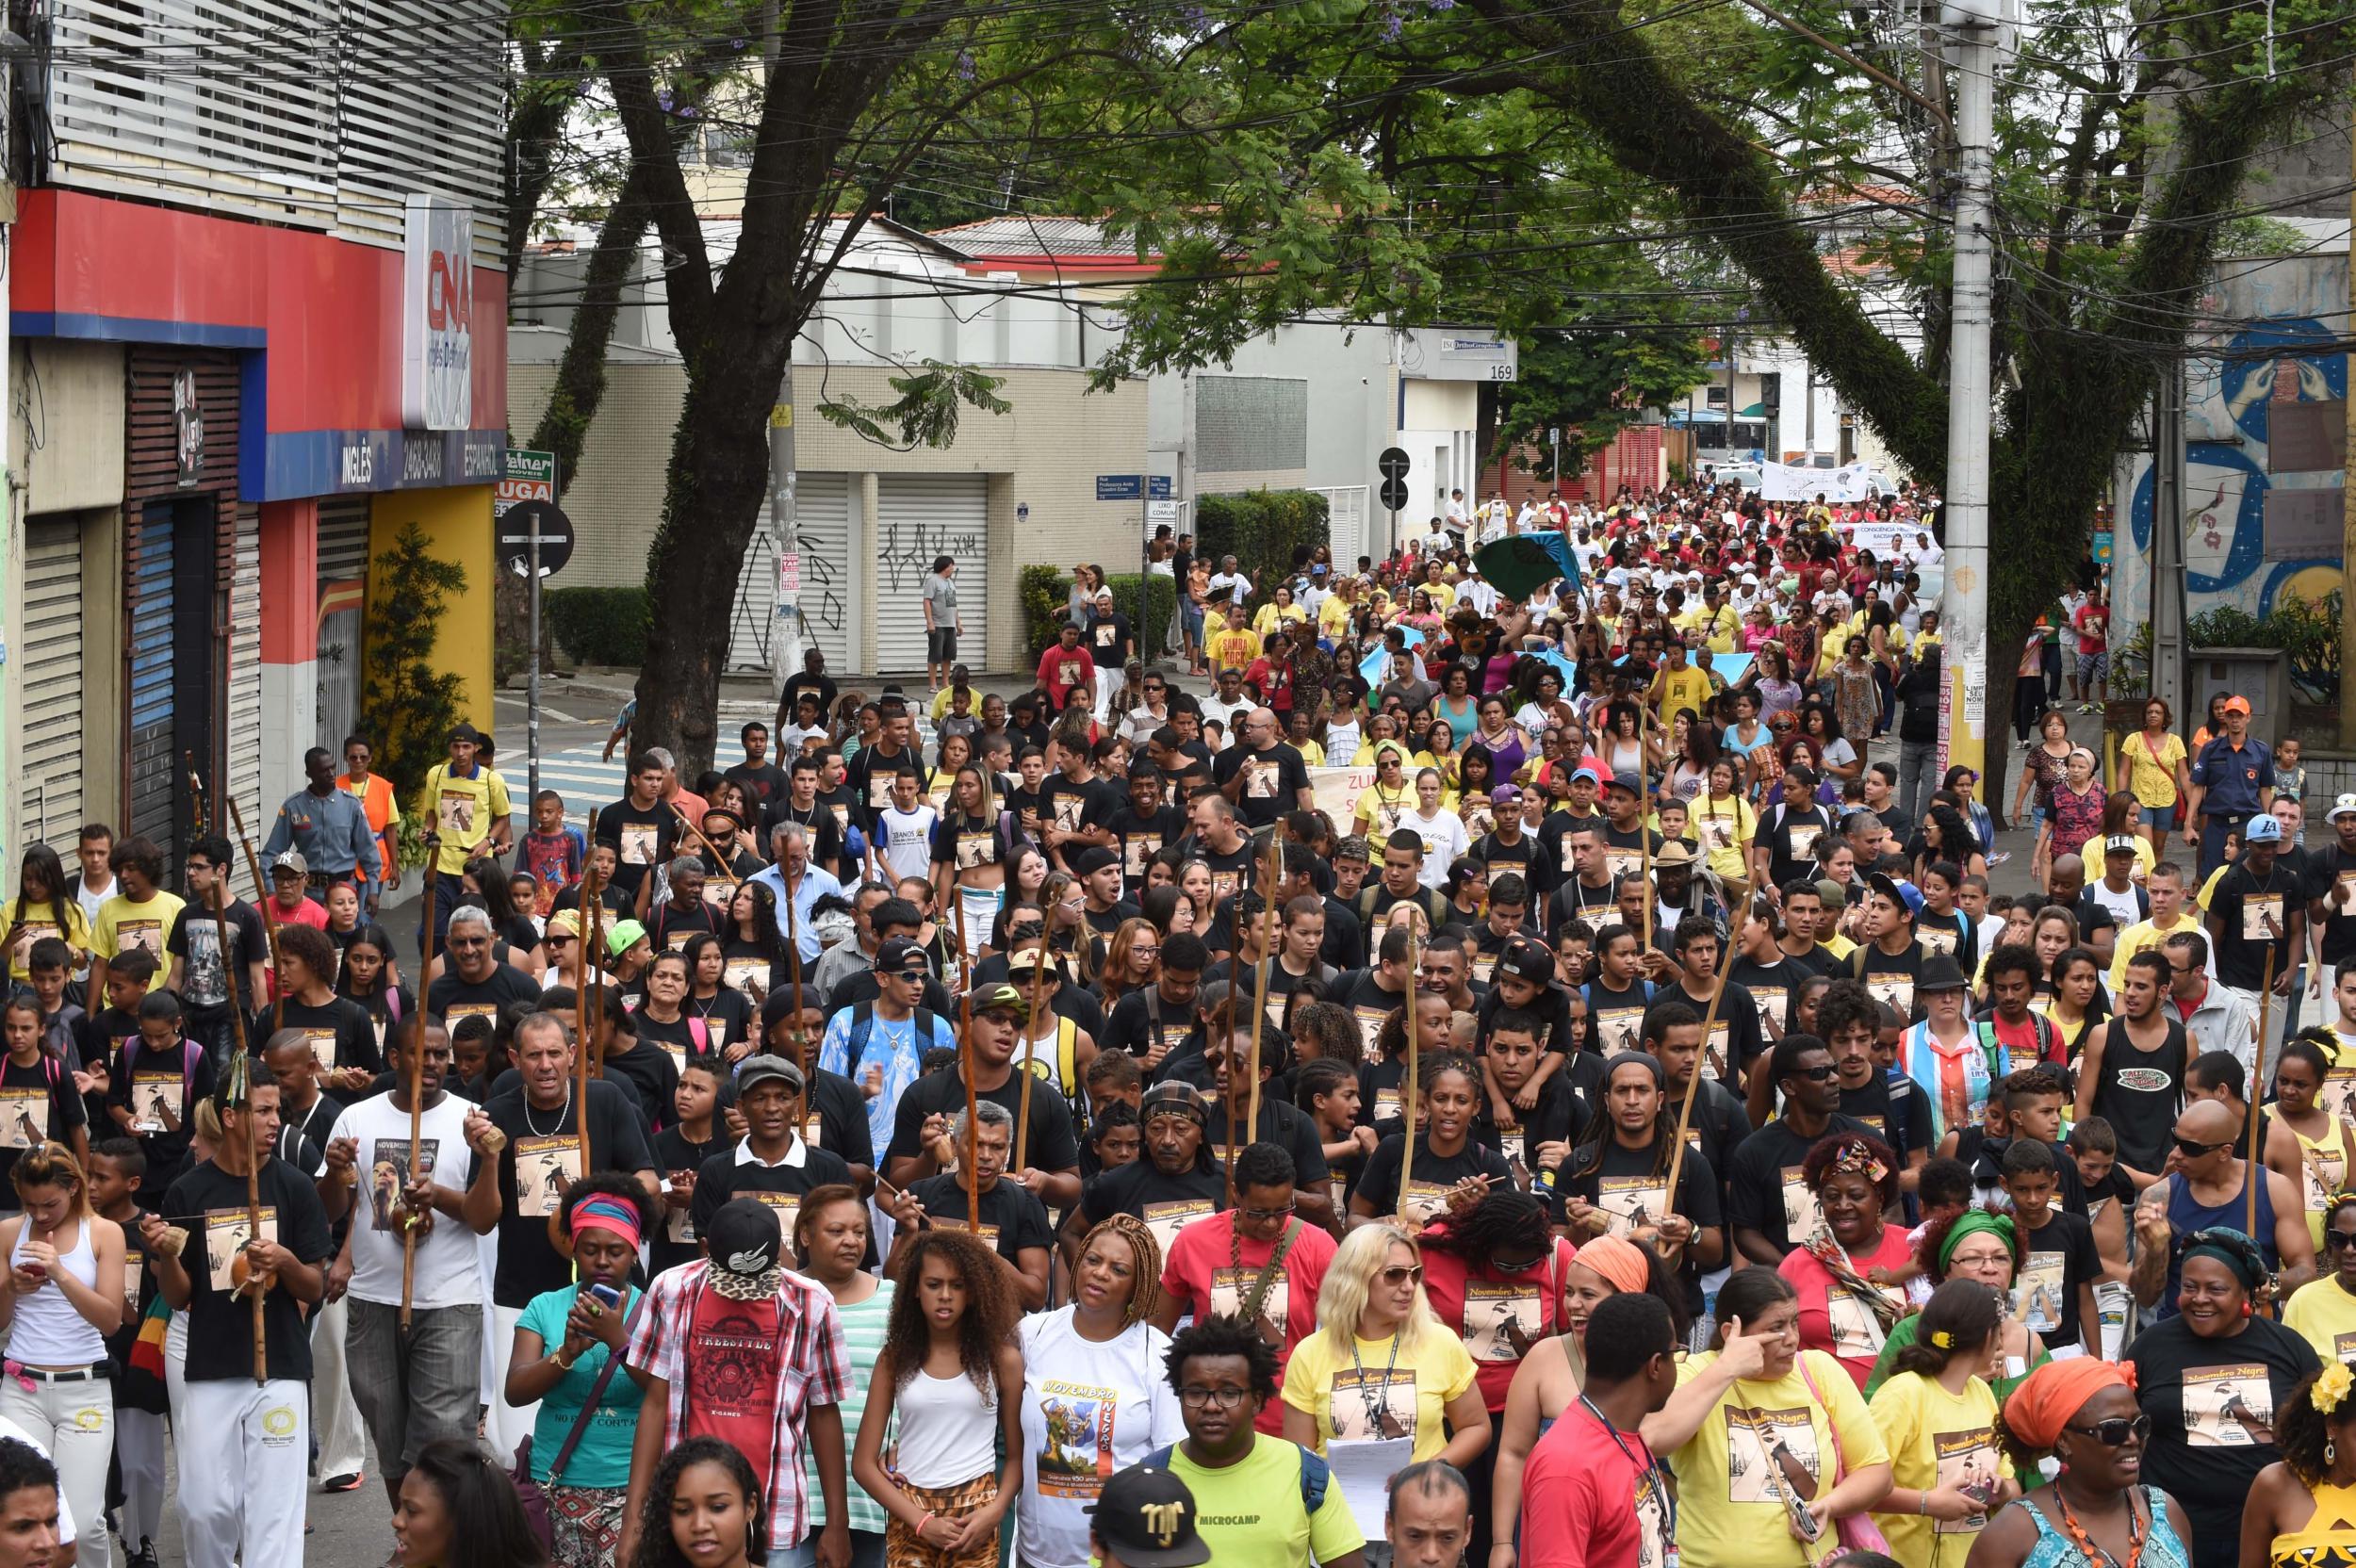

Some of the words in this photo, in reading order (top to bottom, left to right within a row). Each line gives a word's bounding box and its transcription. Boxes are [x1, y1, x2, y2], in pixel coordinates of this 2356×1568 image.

[429, 250, 470, 333] CNA
[1491, 365, 1512, 380] 169
[342, 437, 371, 483] INGLÊS
[403, 439, 441, 482] 2468-3488
[465, 444, 498, 477] ESPANHOL
[1222, 638, 1247, 651] SAMBA
[1225, 652, 1246, 665] ROCK
[1422, 832, 1449, 844] OEIRA
[517, 1141, 558, 1152] Novembro
[559, 1136, 579, 1149] Negr
[1603, 1181, 1643, 1192] Novembro
[1147, 1206, 1186, 1219] Novembro
[1187, 1201, 1213, 1214] Negro
[208, 1213, 248, 1226] Novembro
[1470, 1286, 1513, 1297] Novembro
[1513, 1285, 1537, 1298] Negro
[698, 1336, 772, 1350] FREESTYLE
[2187, 1367, 2234, 1381] Novembro
[2236, 1366, 2266, 1380] Negro
[1044, 1381, 1116, 1399] NOVEMBRO
[711, 1410, 742, 1418] X-GAMES
[1776, 1413, 1807, 1426] Negro
[1100, 1401, 1116, 1451] NEGRO
[1199, 1514, 1261, 1527] MICROCAMP
